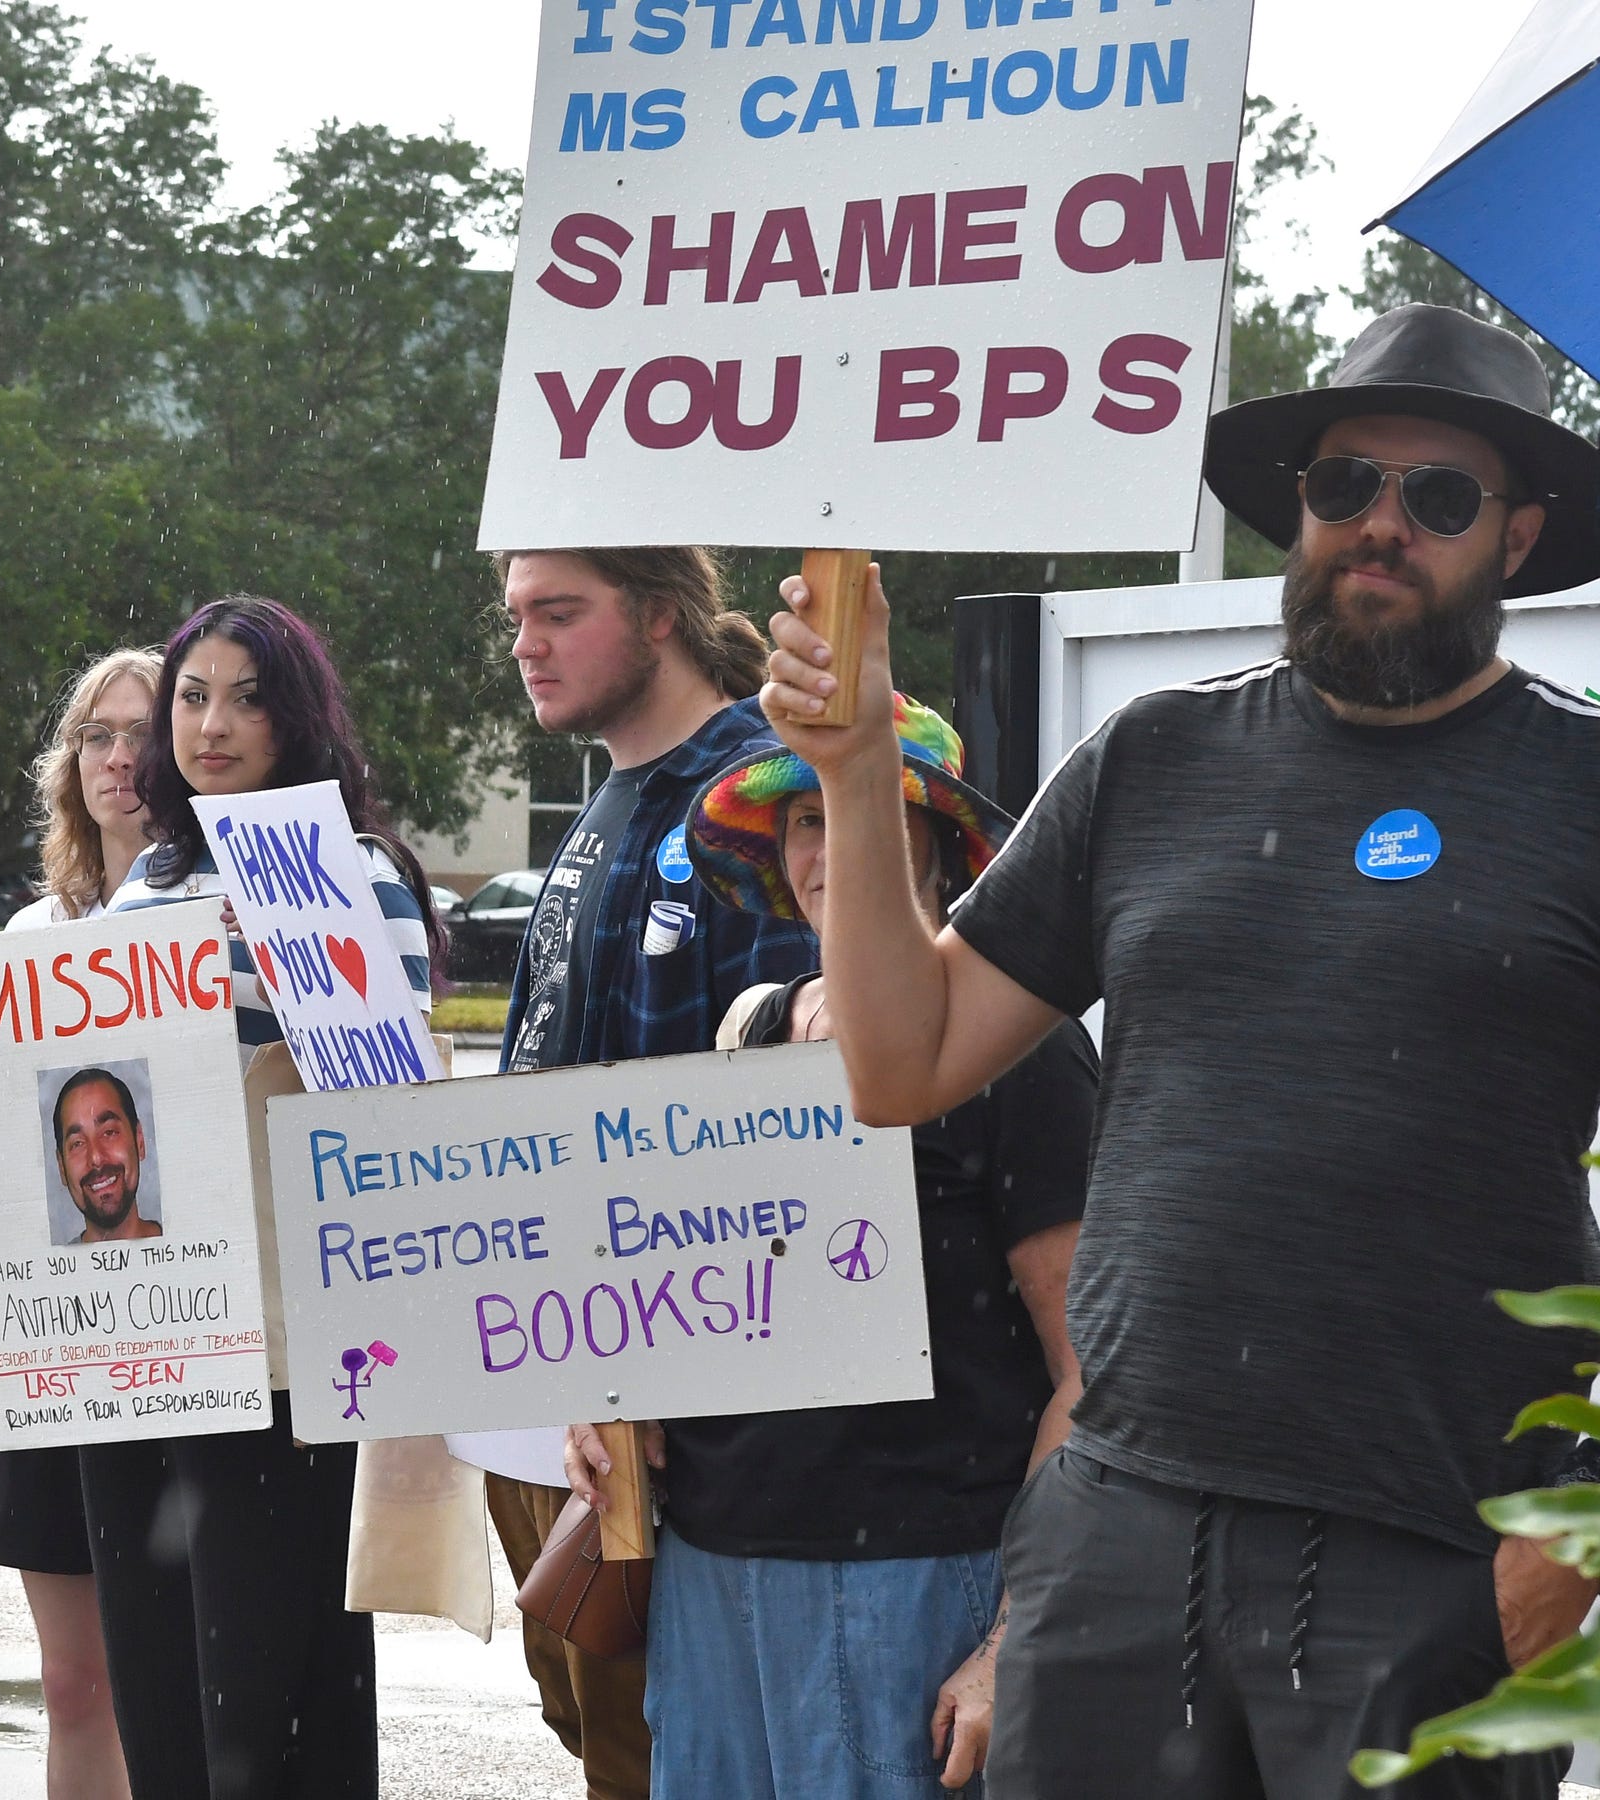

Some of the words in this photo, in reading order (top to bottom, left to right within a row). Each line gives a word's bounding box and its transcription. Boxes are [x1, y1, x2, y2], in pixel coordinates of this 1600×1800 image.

[573, 0, 614, 54] I
[628, 0, 938, 54] STAND
[558, 88, 687, 153] MS
[738, 37, 1190, 141] CALHOUN
[536, 185, 1028, 310] SHAME
[1054, 160, 1235, 274] ON
[534, 353, 803, 460] YOU
[873, 332, 1193, 443] BPS
[665, 844, 683, 855] with
[1366, 853, 1431, 867] Calhoun
[1367, 841, 1403, 856] with
[1368, 832, 1375, 844] I
[1376, 824, 1418, 842] stand
[215, 816, 353, 911] THANK
[268, 928, 335, 1005] YOU
[309, 1128, 574, 1202] REINSTATE
[47, 1256, 77, 1276] YOU
[90, 1249, 130, 1272] SEEN
[141, 1246, 175, 1267] THIS
[182, 1239, 229, 1262] MAN?
[318, 1216, 550, 1289] RESTORE
[606, 1197, 807, 1259] BANNED
[2, 1291, 116, 1342] ANTHONY
[128, 1283, 229, 1331] COLUCCI
[475, 1258, 774, 1373] BOOKS!!
[42, 1349, 53, 1364] OF
[115, 1338, 179, 1358] FEDERATION
[183, 1337, 197, 1351] OF
[203, 1330, 264, 1350] TEACHERS
[24, 1372, 80, 1399] LAST
[108, 1362, 186, 1392] SEEN
[5, 1404, 73, 1431] RUNNING
[84, 1399, 122, 1422] FROM
[133, 1389, 263, 1418] RESPONSIBILITIES
